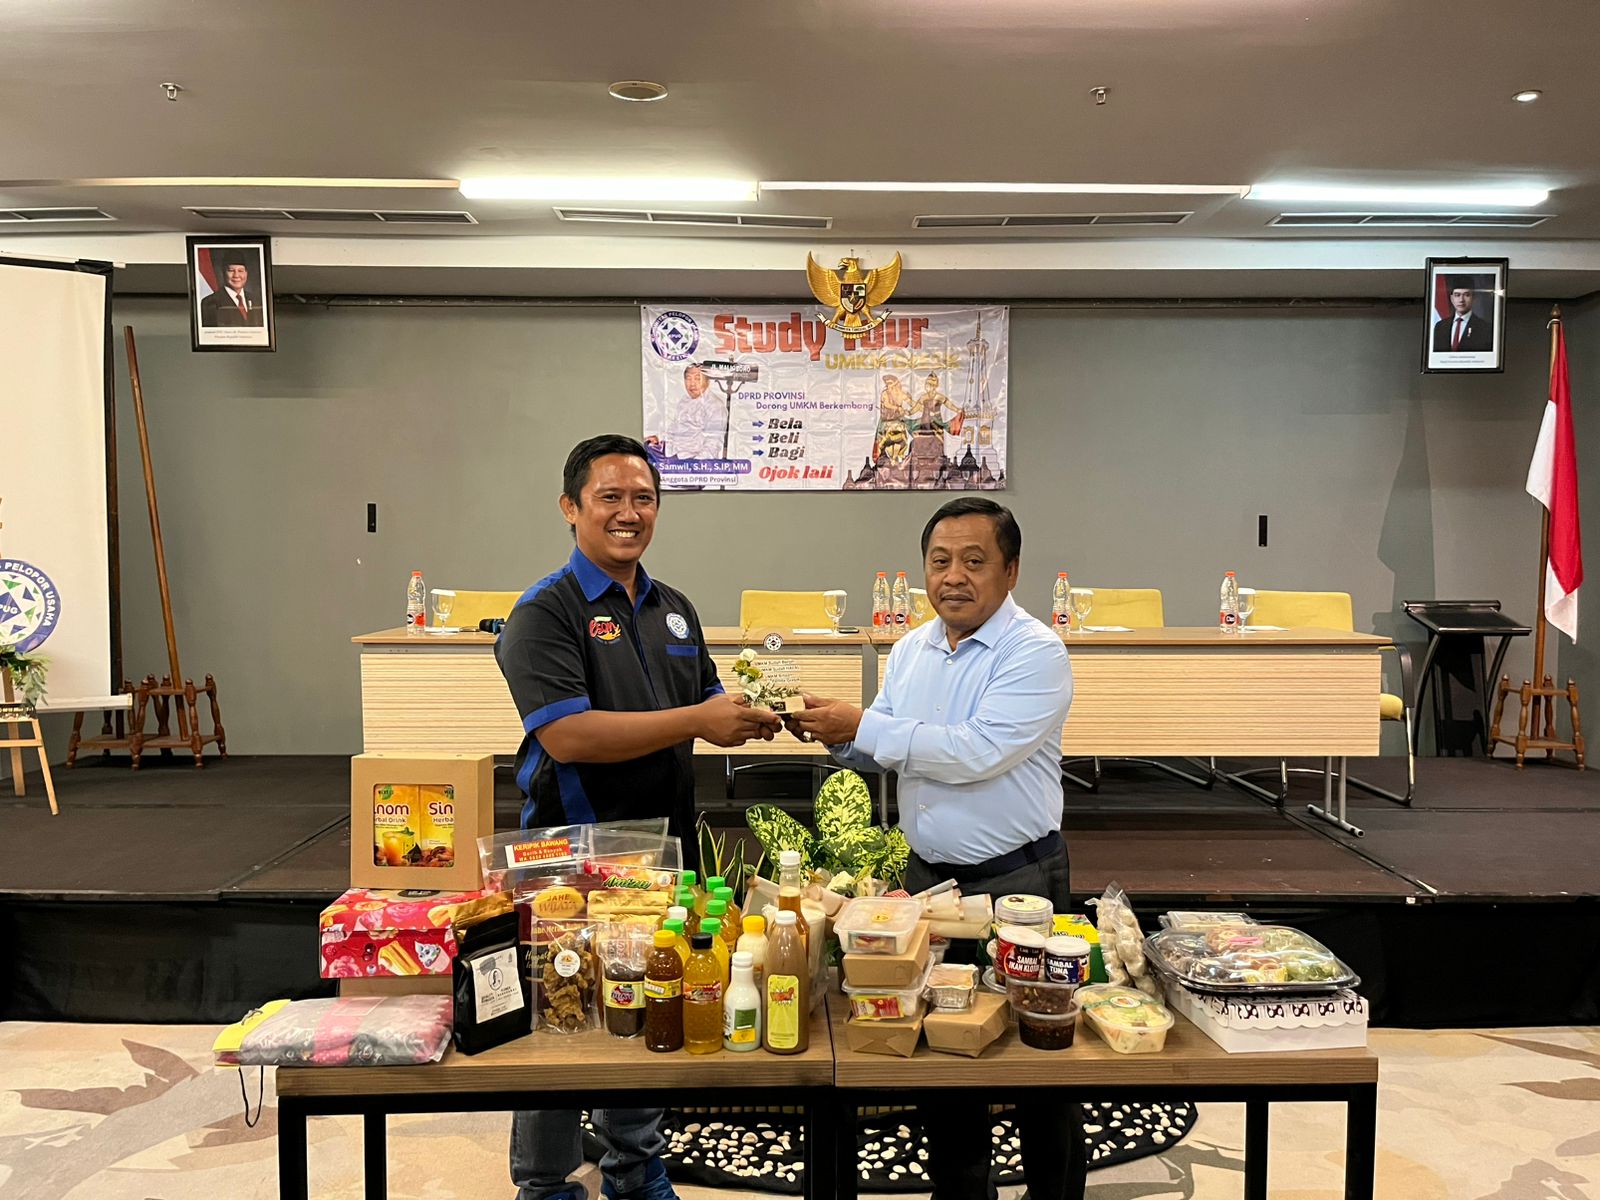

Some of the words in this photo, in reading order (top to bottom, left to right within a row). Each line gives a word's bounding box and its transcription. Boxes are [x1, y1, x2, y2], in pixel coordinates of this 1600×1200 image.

[713, 312, 827, 362] Study
[738, 392, 761, 400] DPRD
[763, 392, 805, 400] PROVINSI
[756, 402, 788, 411] Dorong
[819, 402, 874, 411] Berkembang
[767, 418, 803, 429] Bela
[767, 432, 800, 444] Beli
[767, 446, 806, 460] Bagi
[659, 462, 692, 472] Samwil,
[732, 462, 748, 471] MM
[758, 466, 799, 482] Ojok
[802, 465, 834, 479] lali
[5, 562, 50, 591] PELOPOR
[42, 591, 56, 626] USAHA
[374, 804, 409, 815] nom
[514, 842, 541, 851] KERIPIK
[541, 839, 568, 848] BAWANG
[1008, 961, 1024, 971] IKAN
[1046, 960, 1073, 968] SAMBAL
[1049, 965, 1068, 974] TUNA
